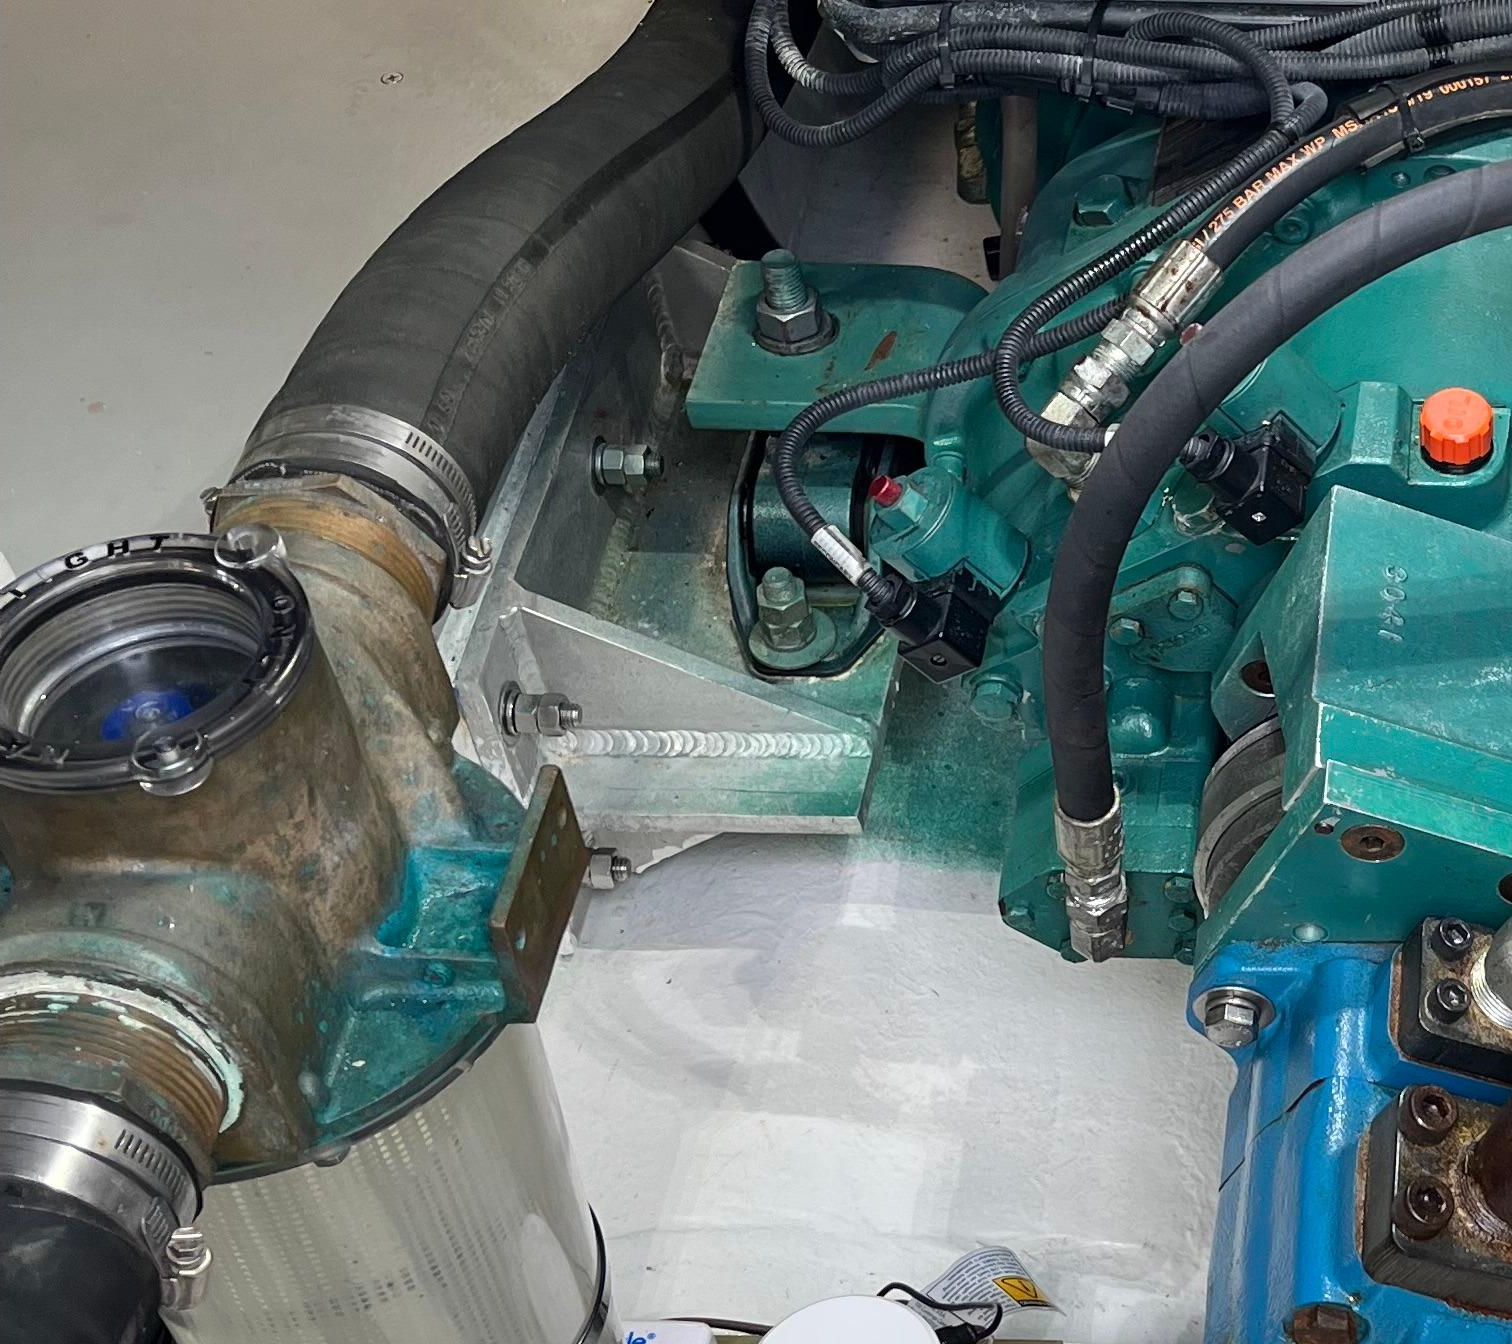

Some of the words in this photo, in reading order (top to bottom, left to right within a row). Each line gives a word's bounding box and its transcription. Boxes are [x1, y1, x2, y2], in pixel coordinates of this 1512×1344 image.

[1208, 206, 1236, 234] 275
[1232, 178, 1265, 209] BAR
[1264, 152, 1299, 184] MAX
[1299, 135, 1327, 163] WP
